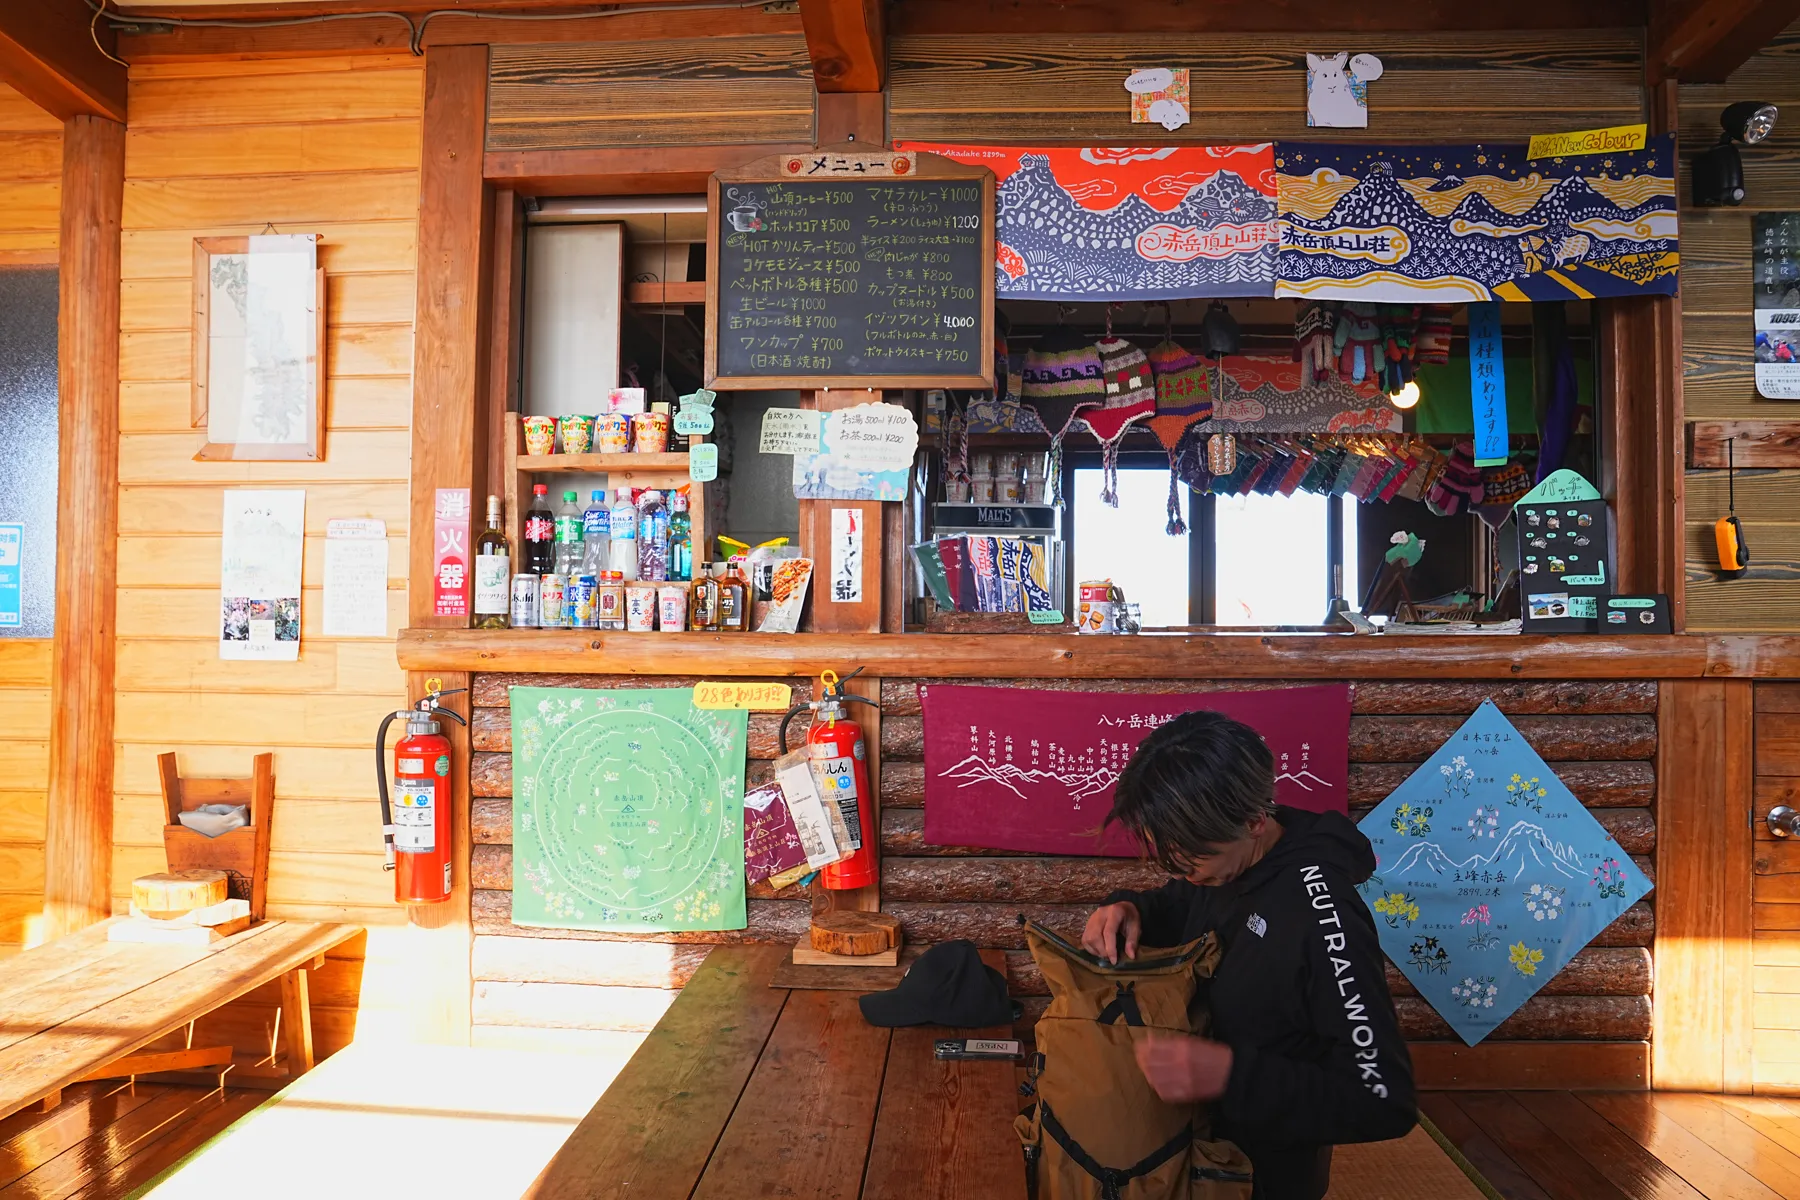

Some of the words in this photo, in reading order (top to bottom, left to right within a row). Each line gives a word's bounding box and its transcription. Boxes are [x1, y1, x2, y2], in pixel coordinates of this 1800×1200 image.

[808, 156, 885, 174] メニュー
[766, 184, 782, 194] HOT
[866, 188, 937, 201] マサラカレー
[771, 192, 824, 205] 山頂コーヒー
[825, 191, 853, 204] ¥500
[769, 220, 818, 232] ホットココア
[821, 220, 850, 232] ¥500
[728, 234, 745, 245] NEW
[744, 240, 769, 252] HOT
[772, 240, 824, 253] かりんティー
[825, 240, 855, 254] ¥500
[861, 234, 890, 246] 半ライス
[892, 235, 916, 245] ¥200
[1162, 227, 1269, 254] 赤岳頂上山荘
[1281, 226, 1391, 254] 赤岳頂上山荘
[1780, 218, 1789, 275] みんなが主役
[867, 249, 882, 259] NEW
[885, 252, 918, 262] 肉じゃが
[923, 252, 949, 262] ¥800
[1764, 228, 1774, 294] 徳本峠の道直し
[744, 257, 822, 272] コケモモジュース
[827, 259, 860, 274] ¥500
[887, 267, 915, 280] もつ煮
[923, 268, 952, 280] ¥800
[730, 276, 821, 292] ペットボトル各種
[824, 278, 857, 293] ¥500
[868, 283, 936, 296] カップヌードル
[941, 286, 974, 299] ¥500
[740, 297, 787, 311] 生ビール
[893, 298, 936, 308] (お湯付き)
[730, 315, 802, 329] 缶アルコール各種
[806, 316, 836, 328] ¥700
[865, 312, 930, 325] イヅツワイン
[741, 334, 803, 349] ワンカップ
[812, 337, 843, 351] ¥700
[864, 346, 933, 357] ポケットウイスキー
[936, 348, 968, 362] ¥750
[767, 411, 803, 420] 自炊の方へ
[842, 413, 863, 426] お湯
[887, 415, 907, 425] ¥100
[840, 429, 861, 441] お茶
[885, 433, 904, 443] ¥200
[555, 521, 577, 534] prte
[440, 492, 464, 589] 消火器
[1097, 713, 1174, 729] 八ヶ岳連峰
[970, 725, 978, 751] 蓼科山
[1463, 733, 1512, 743] 日本百名山
[988, 730, 996, 765] 大河原峠
[1004, 736, 1013, 761] 北横岳
[1100, 738, 1108, 764] 天狗岳
[1474, 746, 1499, 756] 八ヶ岳
[1048, 743, 1056, 769] 茶臼山
[1057, 747, 1065, 773] 麦草峠
[1068, 754, 1075, 771] 丸山
[1077, 755, 1085, 772] 中山
[1086, 747, 1094, 773] 中山峠
[1111, 743, 1119, 769] 根石岳
[1281, 753, 1289, 770] 西岳
[1073, 794, 1081, 810] 冷山
[1453, 870, 1508, 884] 主峰赤岳
